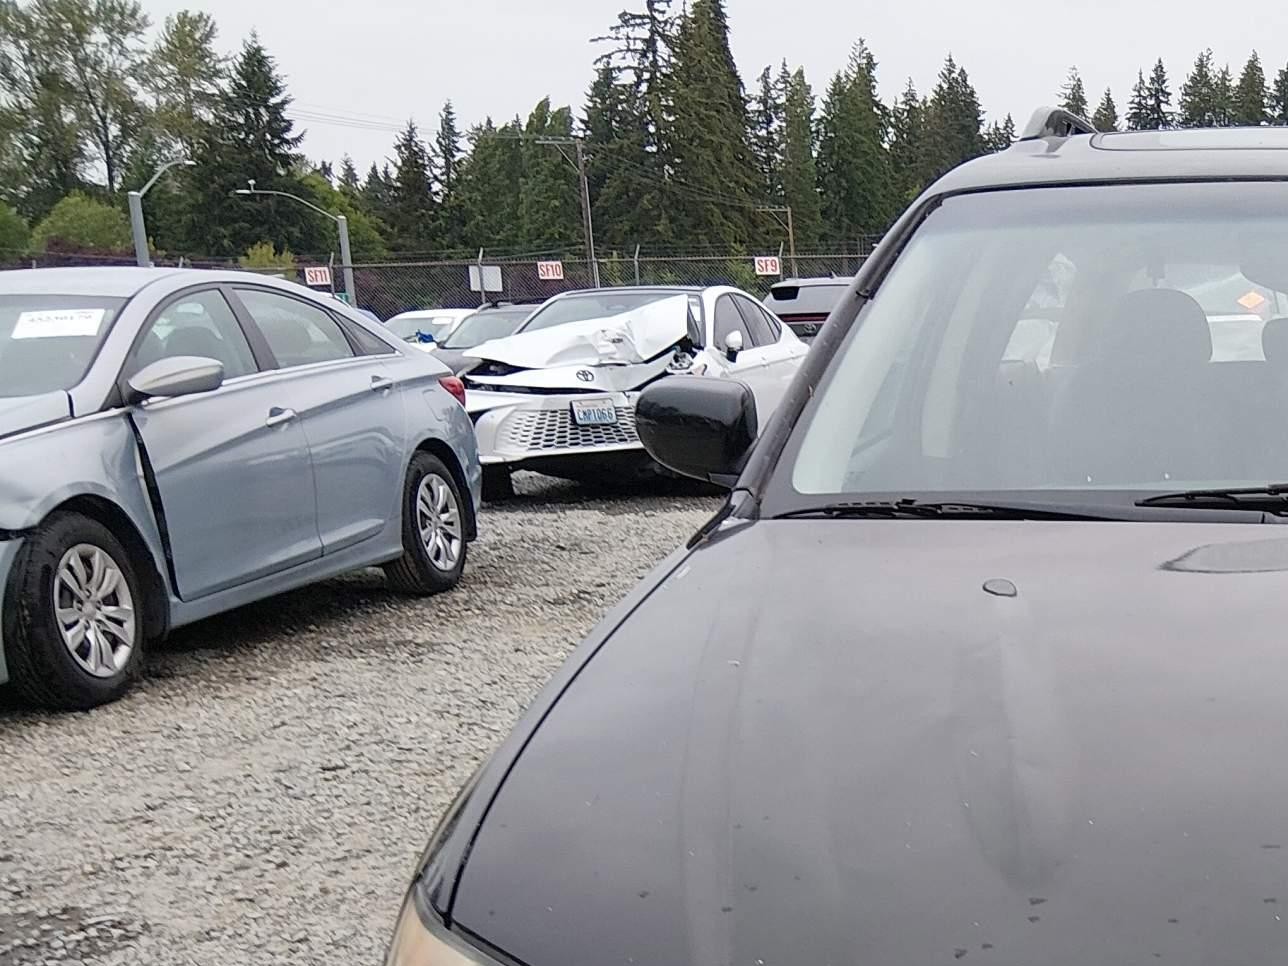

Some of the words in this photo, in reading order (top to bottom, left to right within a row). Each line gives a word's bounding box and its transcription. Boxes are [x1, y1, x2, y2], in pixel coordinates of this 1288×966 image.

[540, 263, 562, 277] SF10
[757, 259, 778, 273] SF9
[308, 270, 328, 283] SF11
